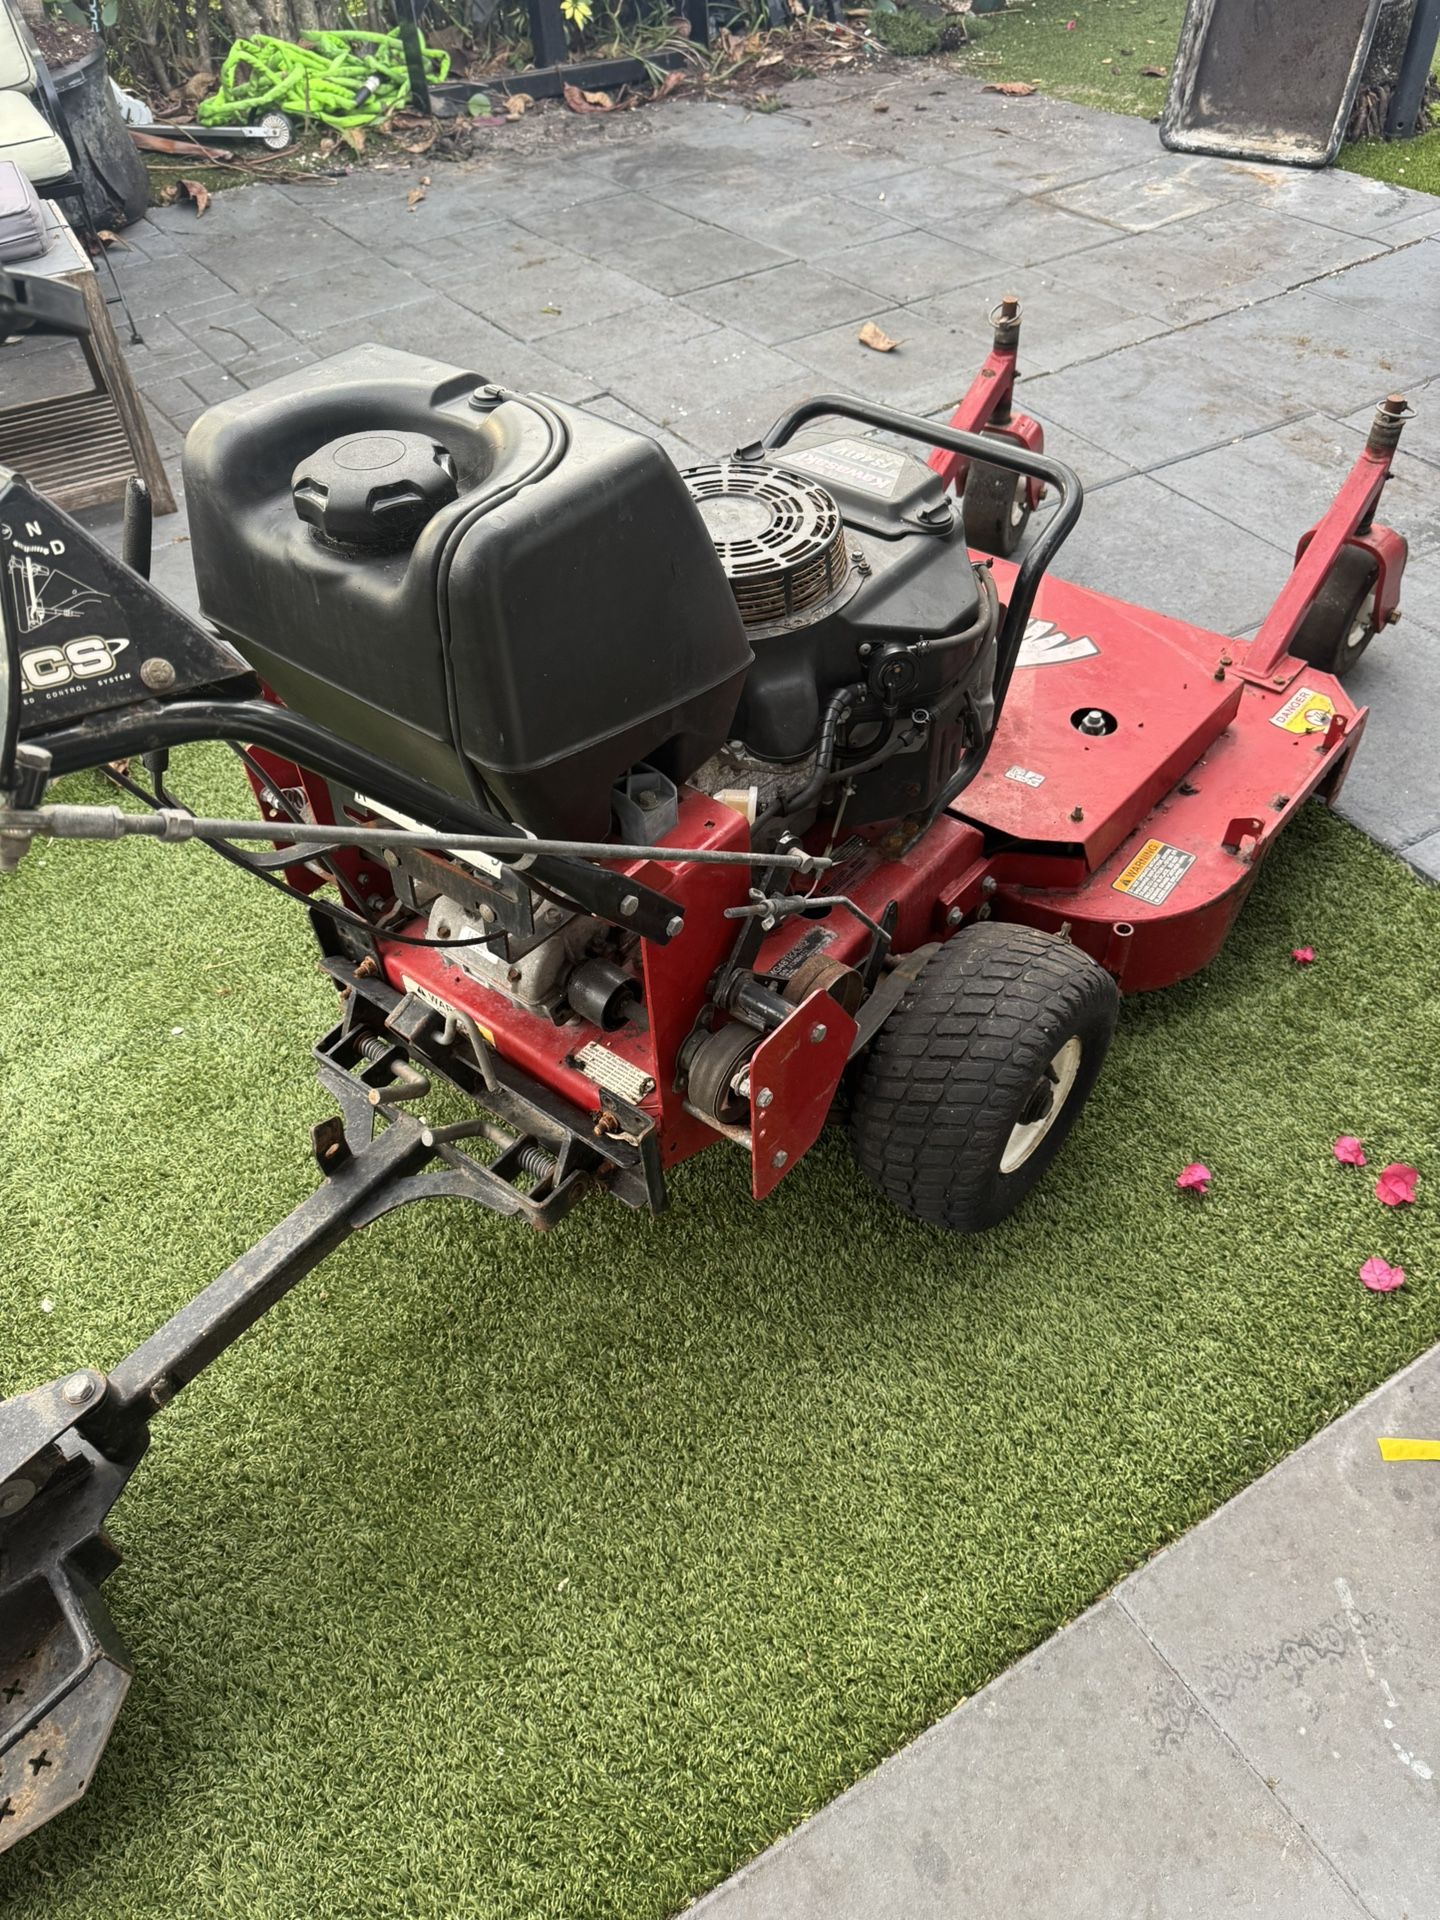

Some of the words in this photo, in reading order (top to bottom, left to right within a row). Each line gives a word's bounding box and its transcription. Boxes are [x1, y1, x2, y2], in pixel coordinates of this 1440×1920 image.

[25, 520, 42, 537] N
[49, 539, 65, 556] D
[20, 634, 117, 694] CS
[45, 684, 88, 700] CONTROL
[97, 672, 132, 687] SYSTEM
[1275, 691, 1310, 723] DANGER
[1126, 843, 1159, 878] WARNING
